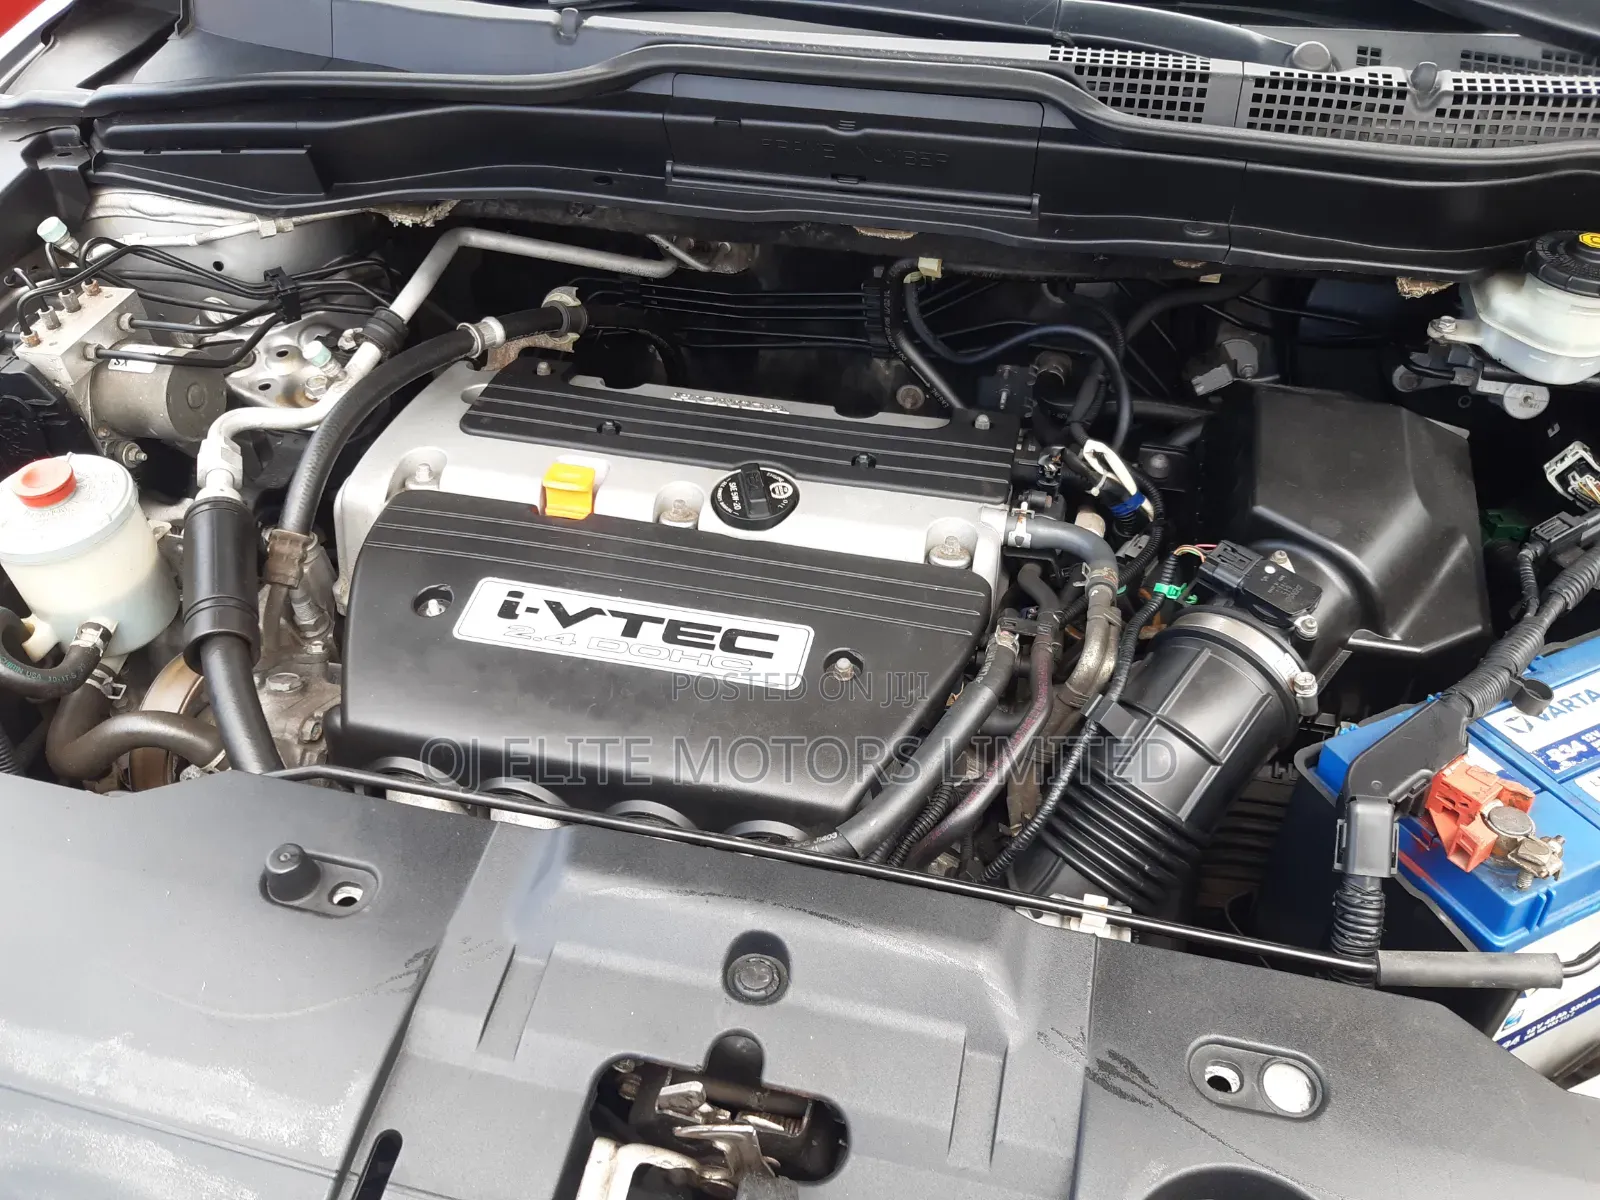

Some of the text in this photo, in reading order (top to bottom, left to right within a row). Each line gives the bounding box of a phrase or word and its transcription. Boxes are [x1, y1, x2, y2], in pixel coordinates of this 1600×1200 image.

[496, 590, 780, 660] i-VTEC
[503, 624, 754, 673] 2.4 DOHC
[25, 670, 42, 680] USA
[1536, 688, 1600, 722] VARTA
